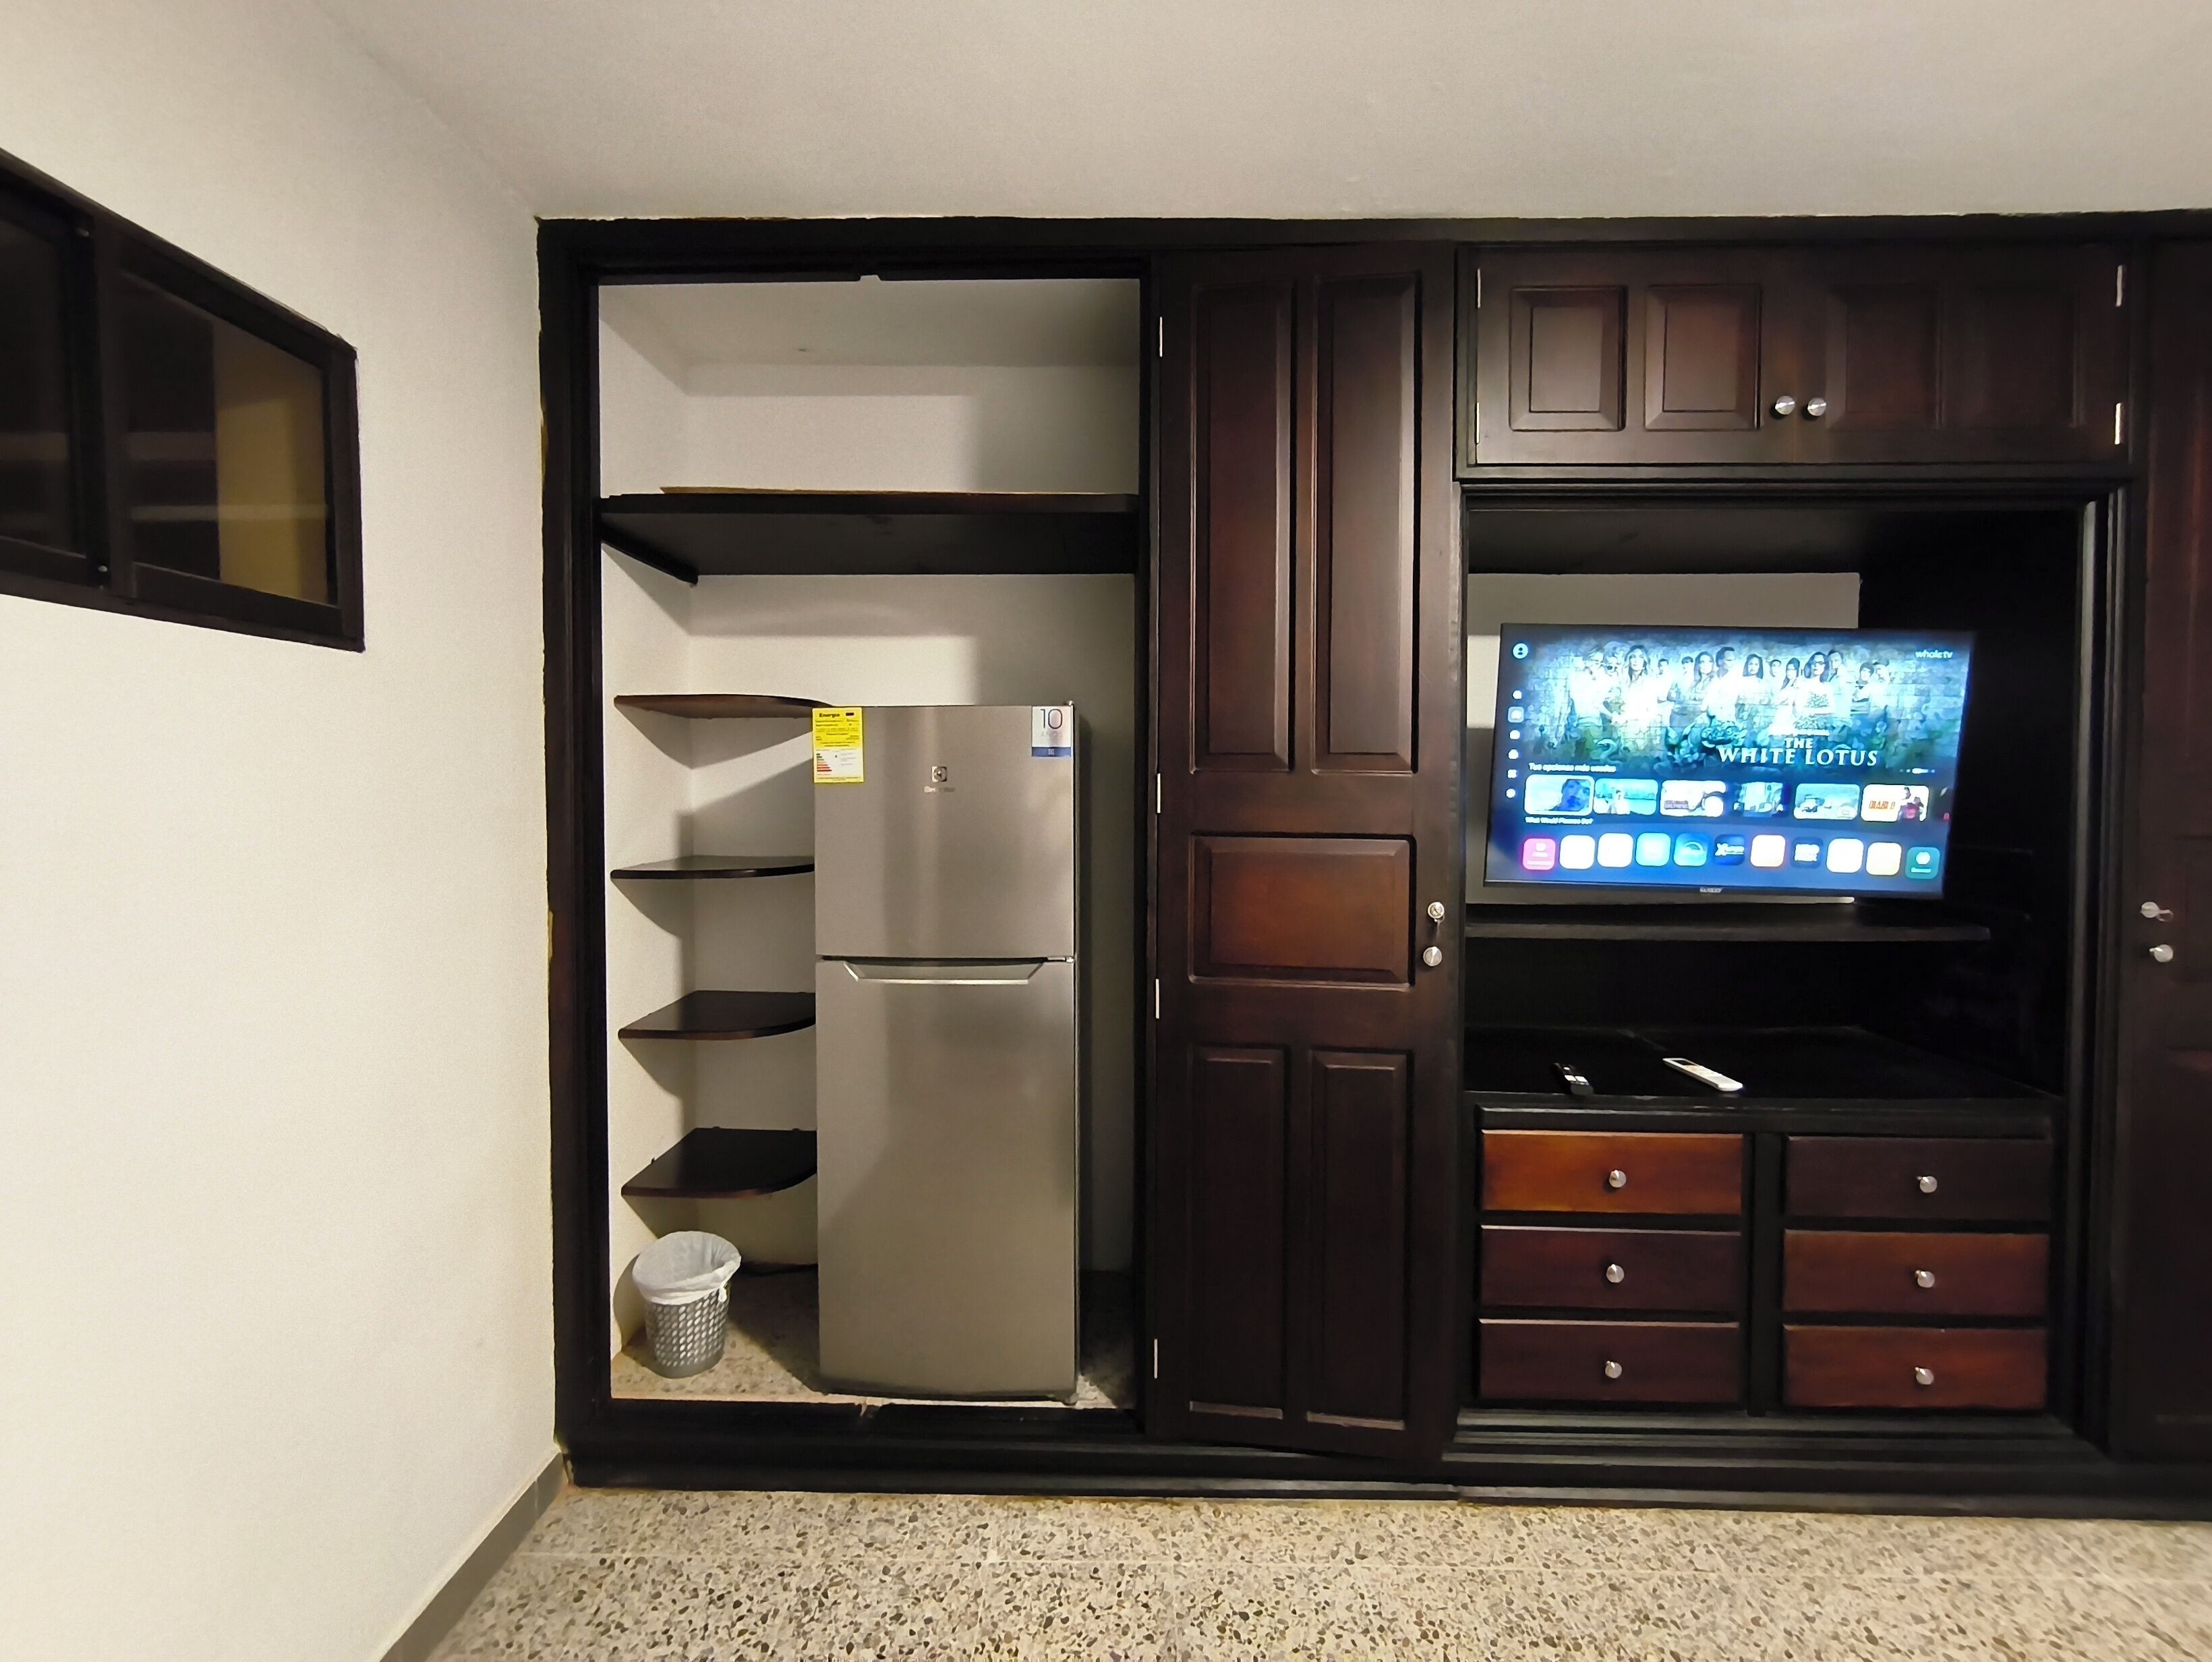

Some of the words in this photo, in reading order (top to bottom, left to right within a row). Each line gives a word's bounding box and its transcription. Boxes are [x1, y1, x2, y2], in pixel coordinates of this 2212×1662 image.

[1041, 708, 1063, 729] 10
[1784, 737, 1813, 749] THE
[1717, 747, 1796, 765] WHITE
[1805, 748, 1878, 766] LOTUS
